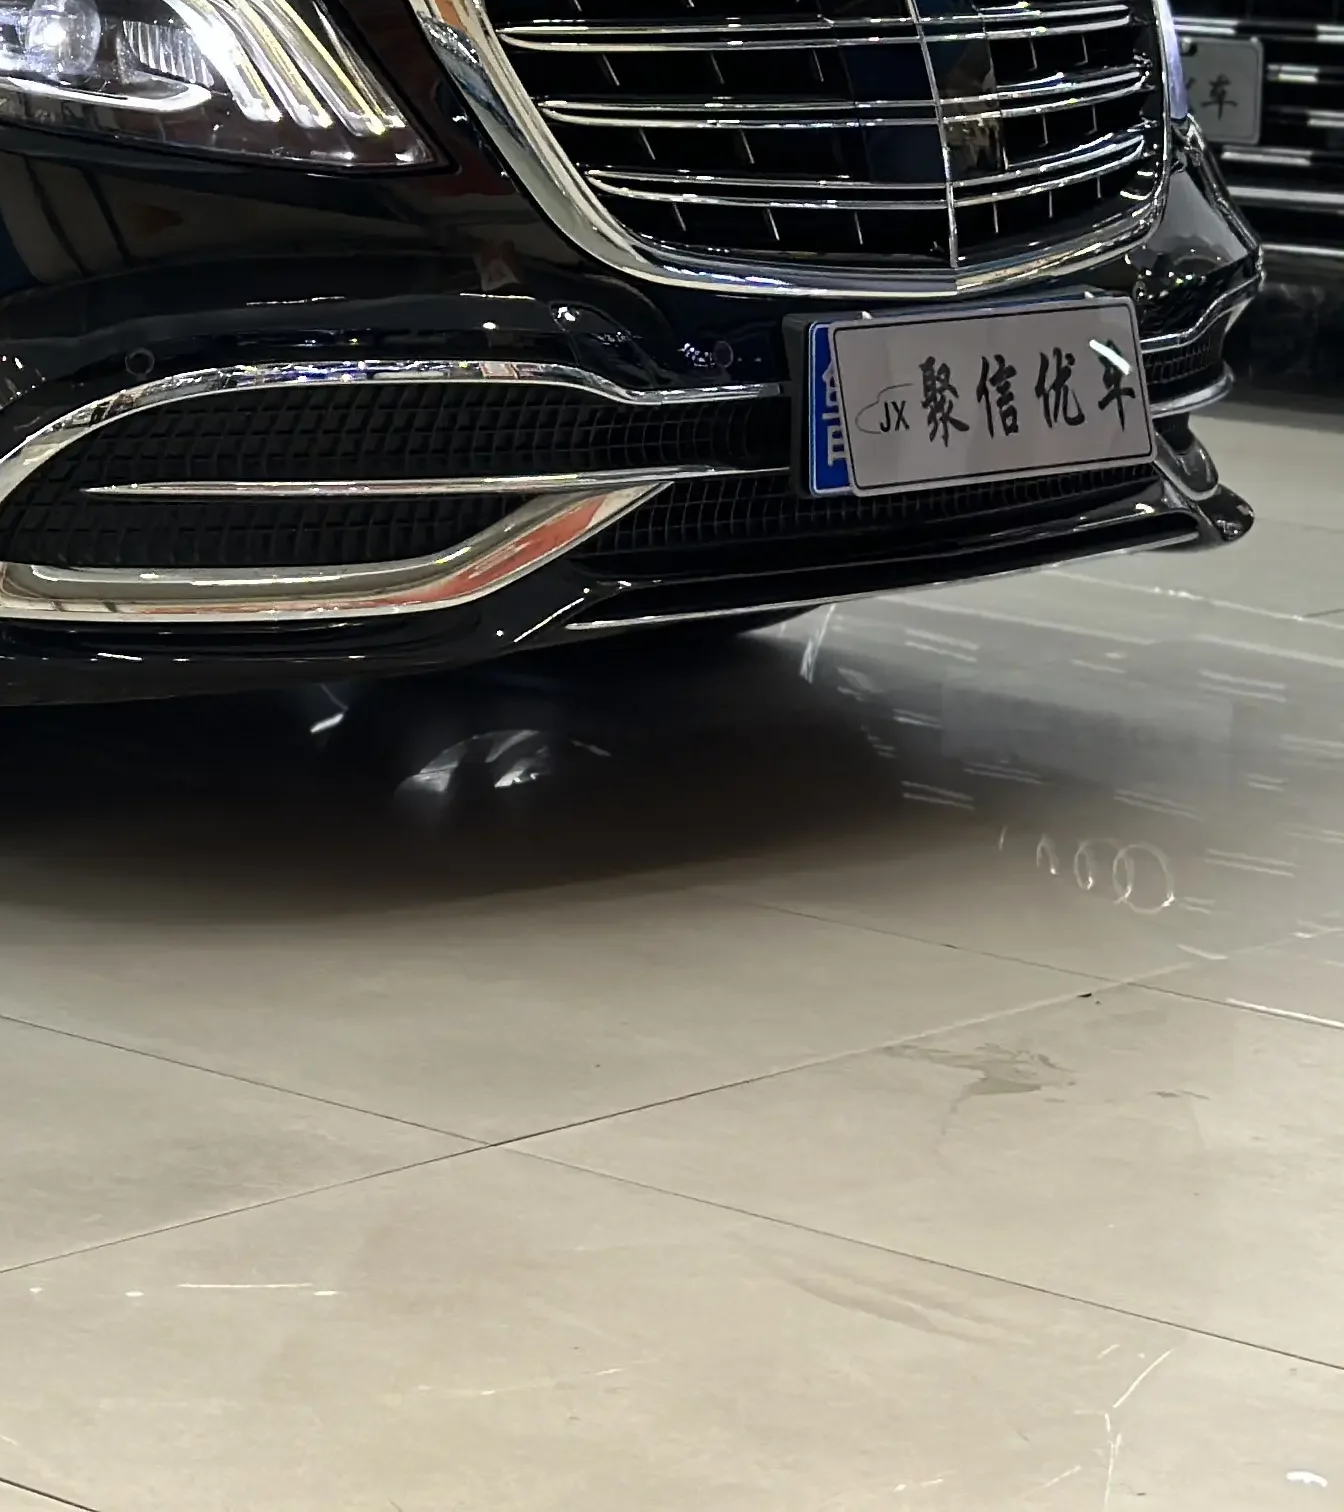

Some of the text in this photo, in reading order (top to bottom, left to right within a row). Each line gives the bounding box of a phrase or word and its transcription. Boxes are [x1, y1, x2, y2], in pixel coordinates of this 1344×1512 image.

[879, 400, 911, 433] JX
[917, 339, 1137, 447] 聚信优车
